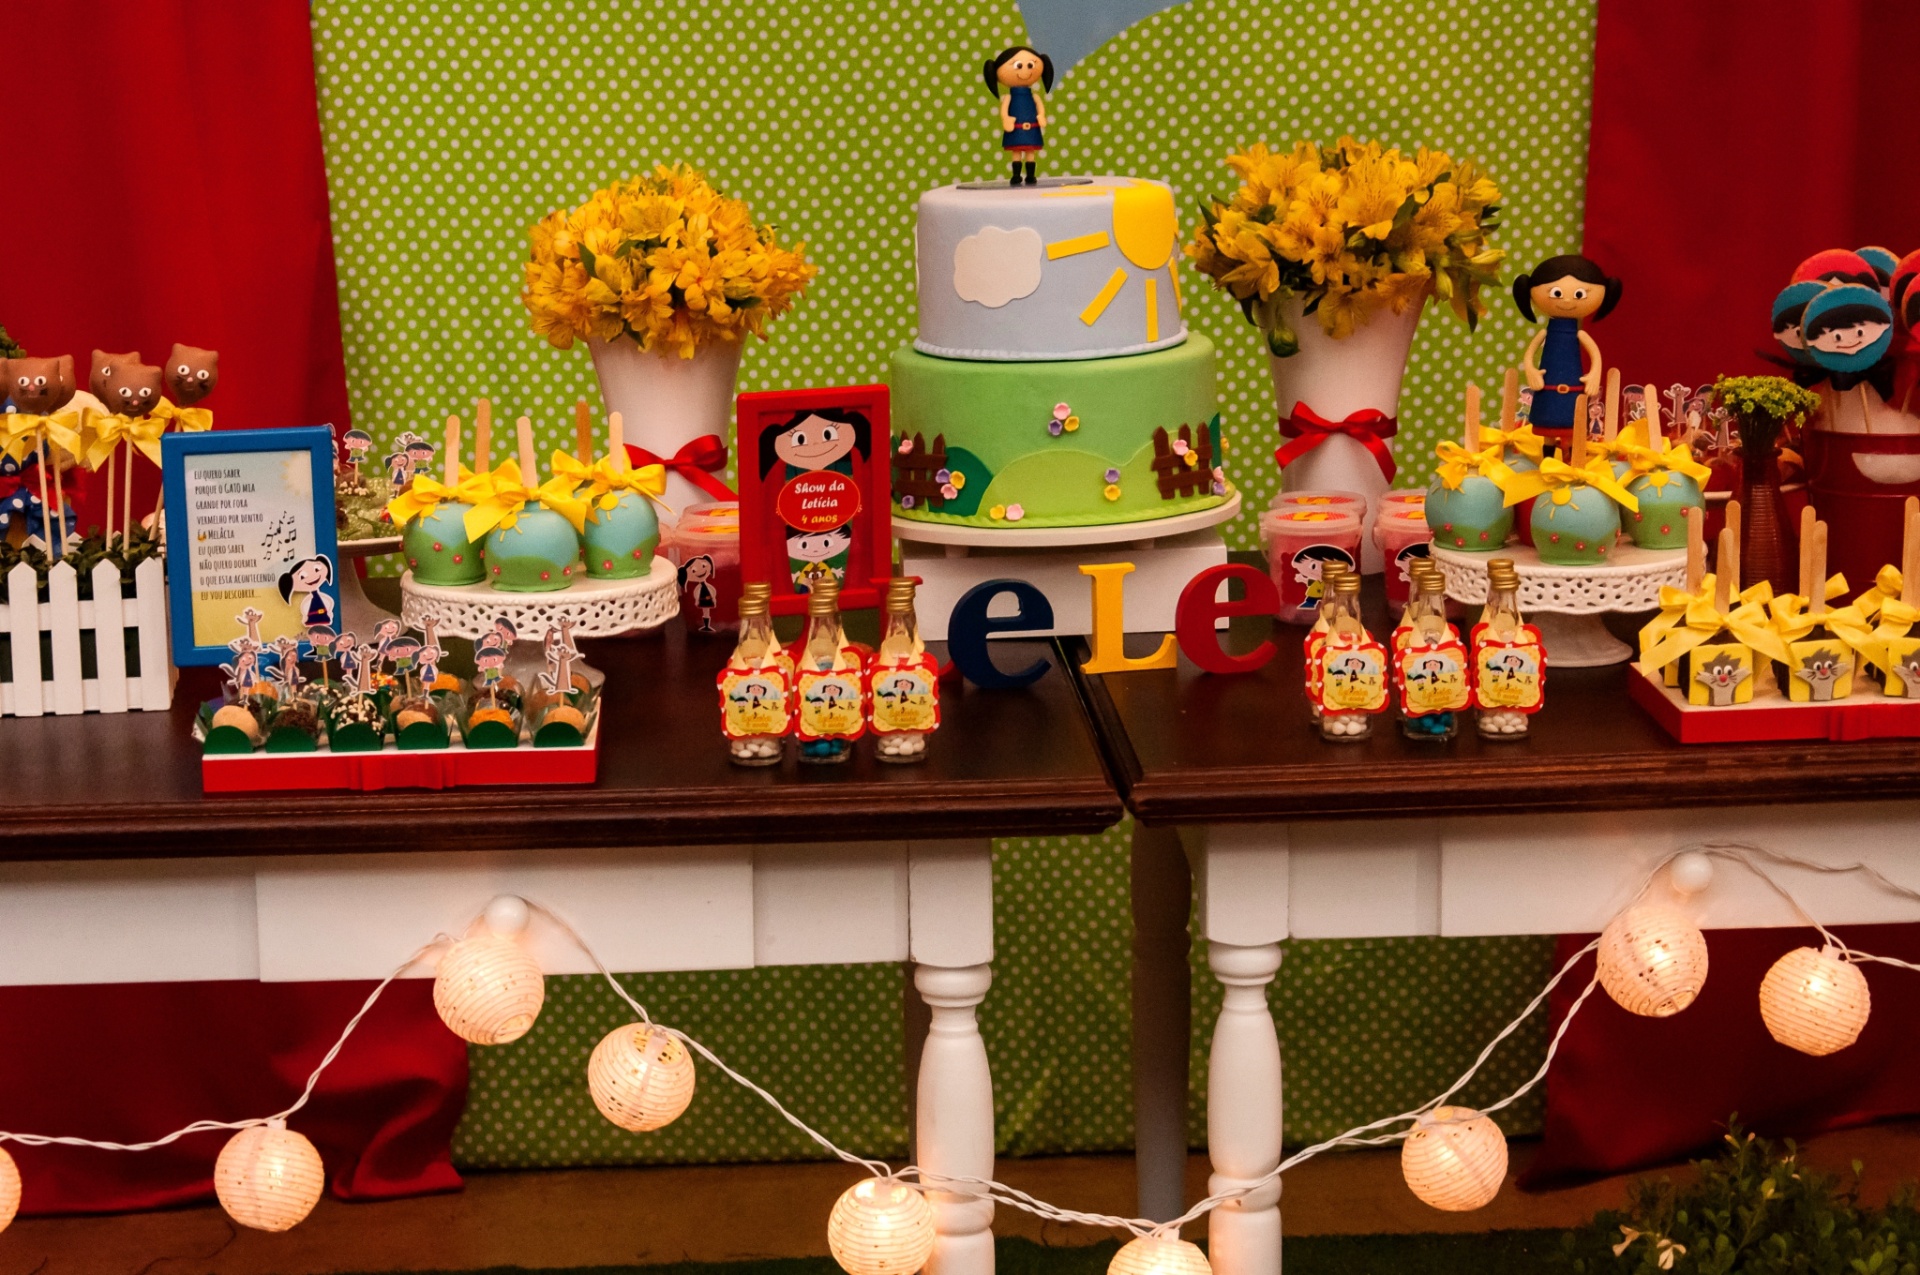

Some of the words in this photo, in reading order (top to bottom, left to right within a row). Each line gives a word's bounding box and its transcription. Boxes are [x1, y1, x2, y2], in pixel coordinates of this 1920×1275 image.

[194, 470, 201, 480] EU
[203, 470, 222, 481] QUERO
[223, 469, 241, 479] SABER
[195, 485, 217, 496] PORQUE
[218, 486, 223, 494] O
[224, 483, 241, 493] GATO
[242, 483, 255, 493] MIA
[794, 482, 825, 494] Show
[828, 480, 845, 492] da
[196, 500, 218, 510] GRANDE
[220, 500, 231, 509] POR
[232, 499, 248, 508] FORA
[801, 496, 838, 510] Letícia
[197, 515, 227, 525] VERMELHO
[228, 514, 239, 523] POR
[241, 513, 264, 523] DENTRO
[801, 514, 808, 524] 4
[811, 514, 838, 524] anos
[198, 546, 206, 555] EU
[207, 545, 226, 557] QUERO
[227, 544, 245, 553] SABER
[199, 558, 212, 570] NÃO
[213, 560, 233, 572] QUERO
[234, 559, 257, 568] DORMIR
[200, 577, 204, 585] O
[205, 576, 217, 587] QUE
[234, 573, 276, 583] ACONTECENDO
[201, 591, 208, 600] EU
[210, 590, 223, 600] VOU
